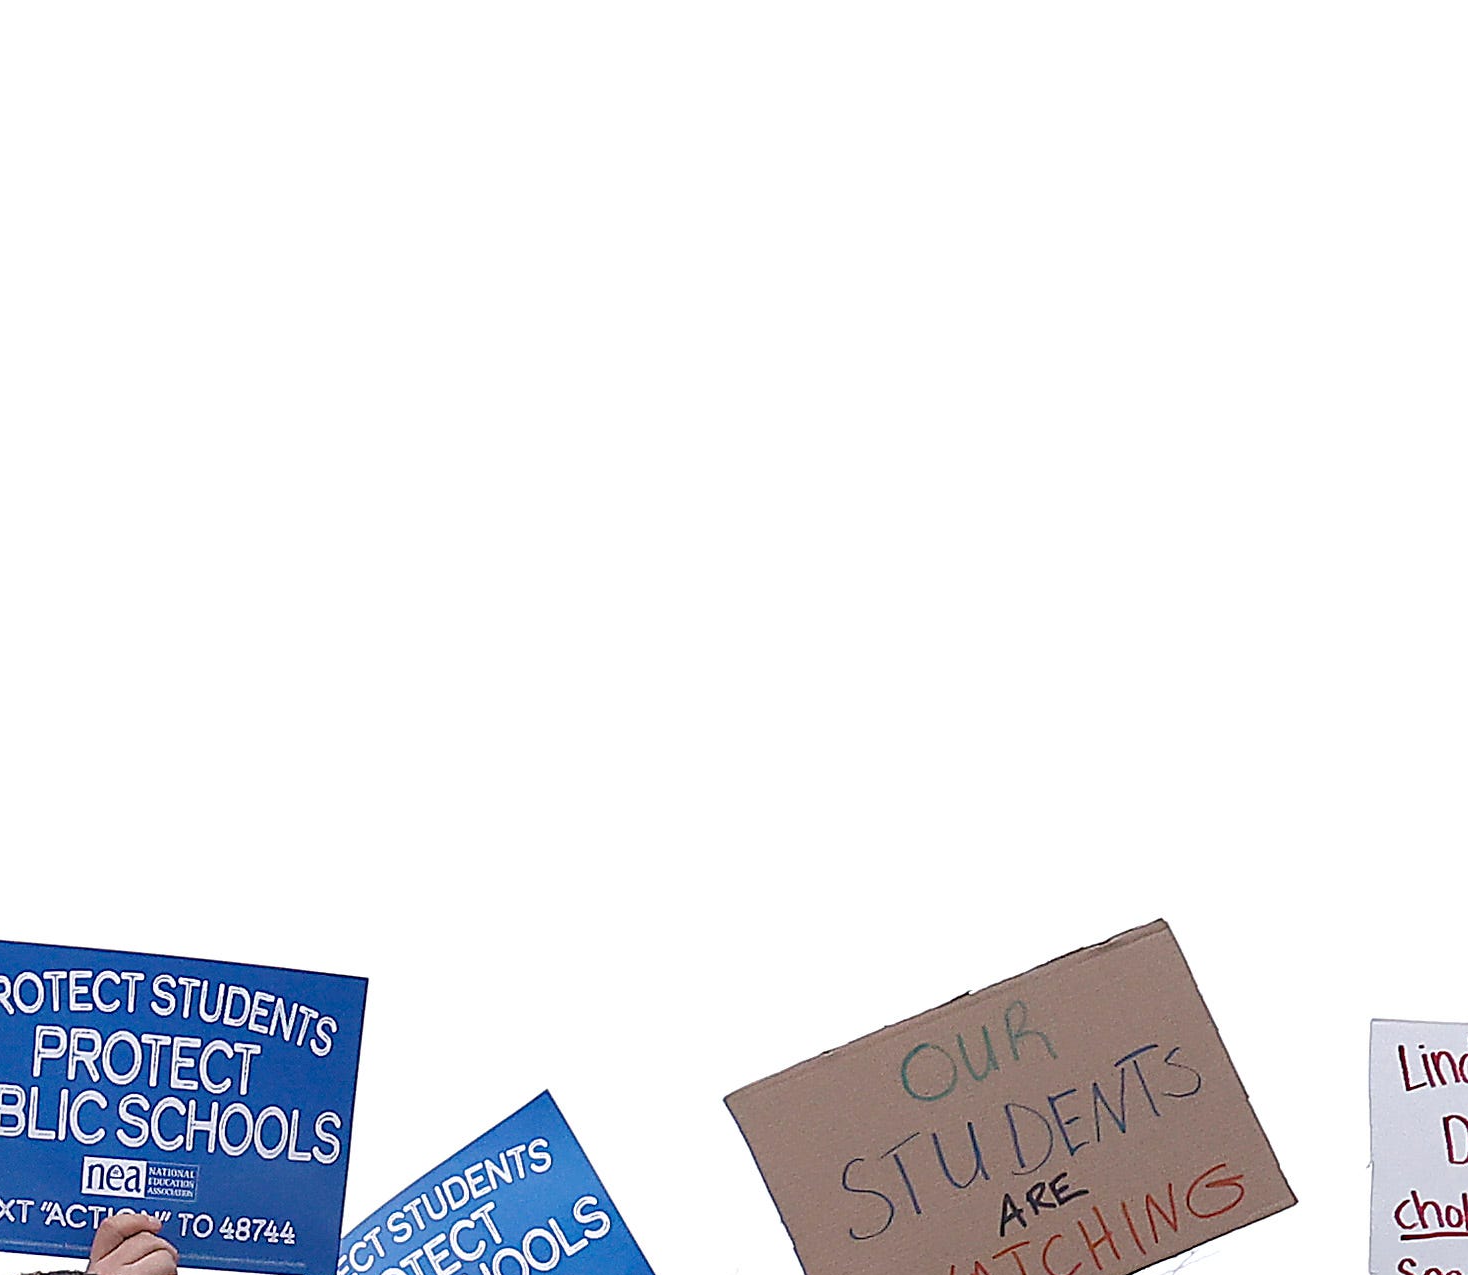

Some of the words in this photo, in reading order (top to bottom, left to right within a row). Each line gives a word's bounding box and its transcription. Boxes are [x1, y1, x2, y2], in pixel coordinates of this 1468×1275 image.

[151, 975, 338, 1057] STUDENTS
[901, 999, 1058, 1101] OUR
[32, 1025, 261, 1096] PROTECT
[116, 1093, 342, 1164] SCHOOLS
[841, 1043, 1202, 1240] STUDENTS
[86, 1164, 141, 1193] nea
[149, 1167, 194, 1178] NATIONAL
[385, 1137, 554, 1244] STUDENTS
[997, 1171, 1089, 1238] ARE
[178, 1213, 213, 1237] TO
[219, 1216, 295, 1245] 48744
